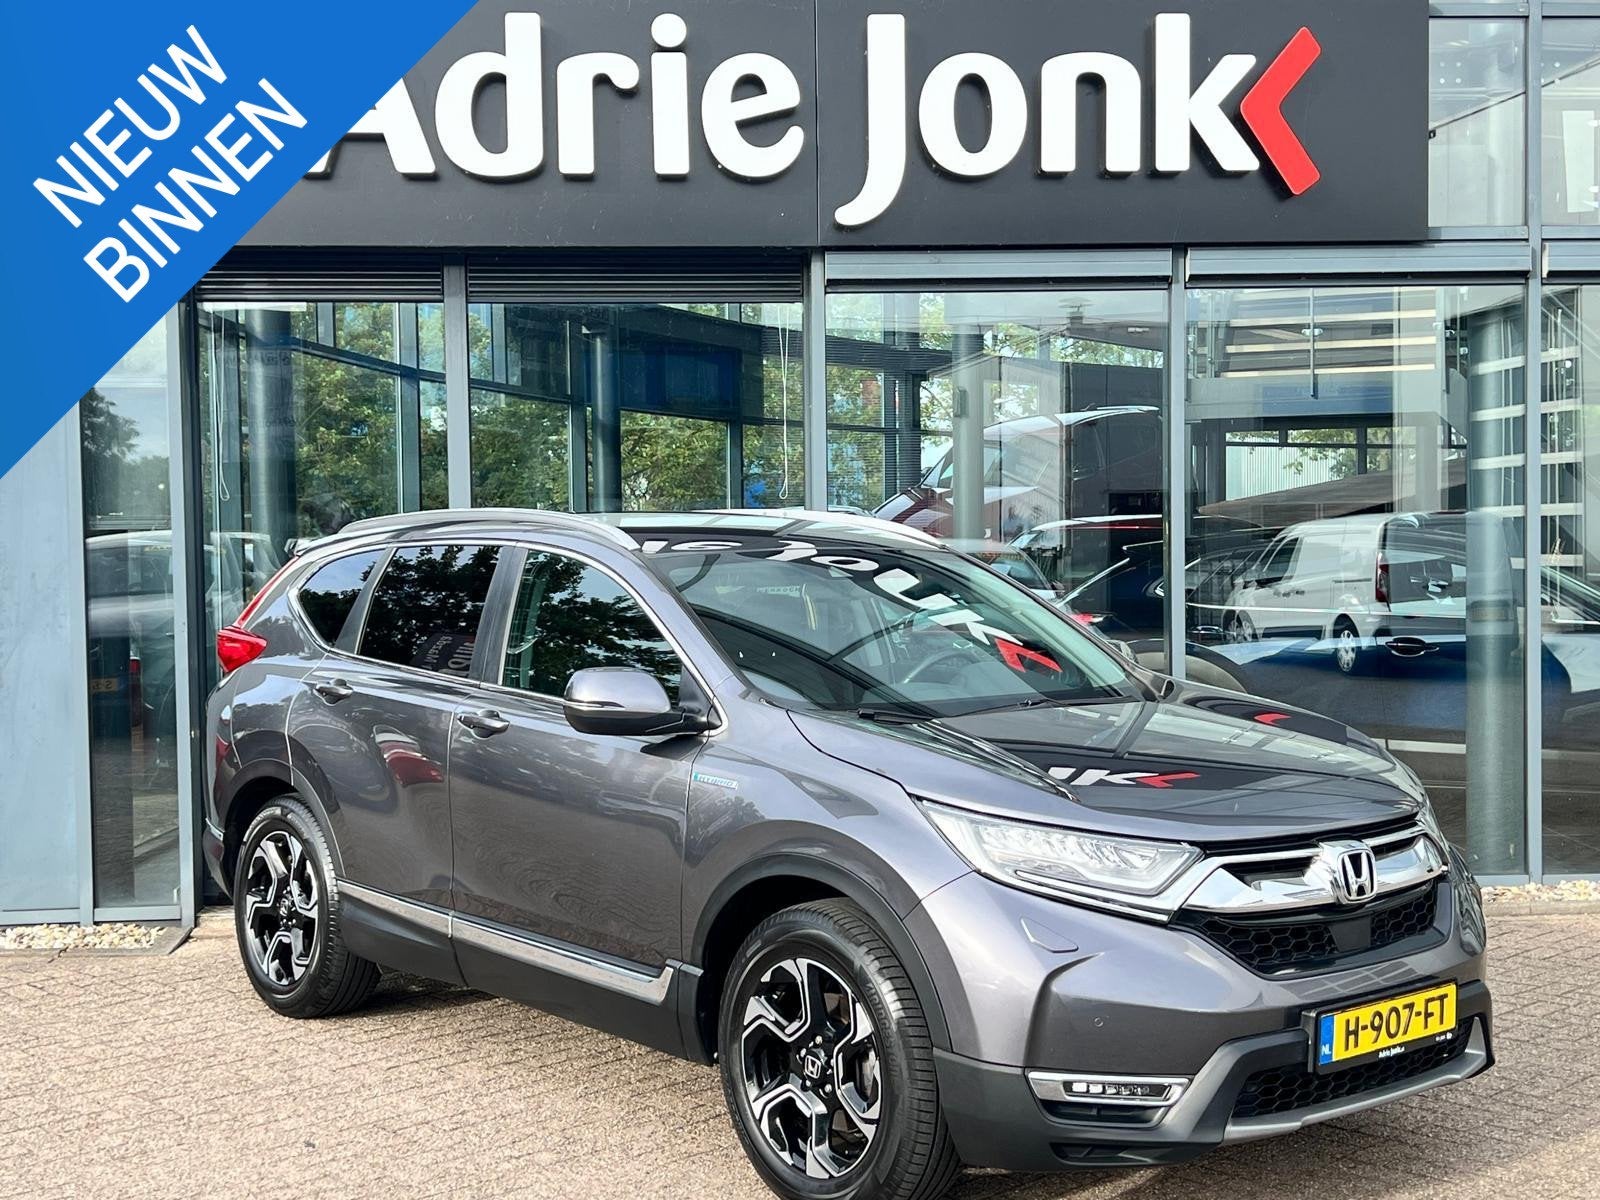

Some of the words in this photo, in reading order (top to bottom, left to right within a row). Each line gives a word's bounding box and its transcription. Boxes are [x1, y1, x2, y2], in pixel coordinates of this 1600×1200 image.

[835, 13, 1260, 227] Jonk
[1321, 1044, 1332, 1056] NL
[1344, 992, 1449, 1052] H-907-FT
